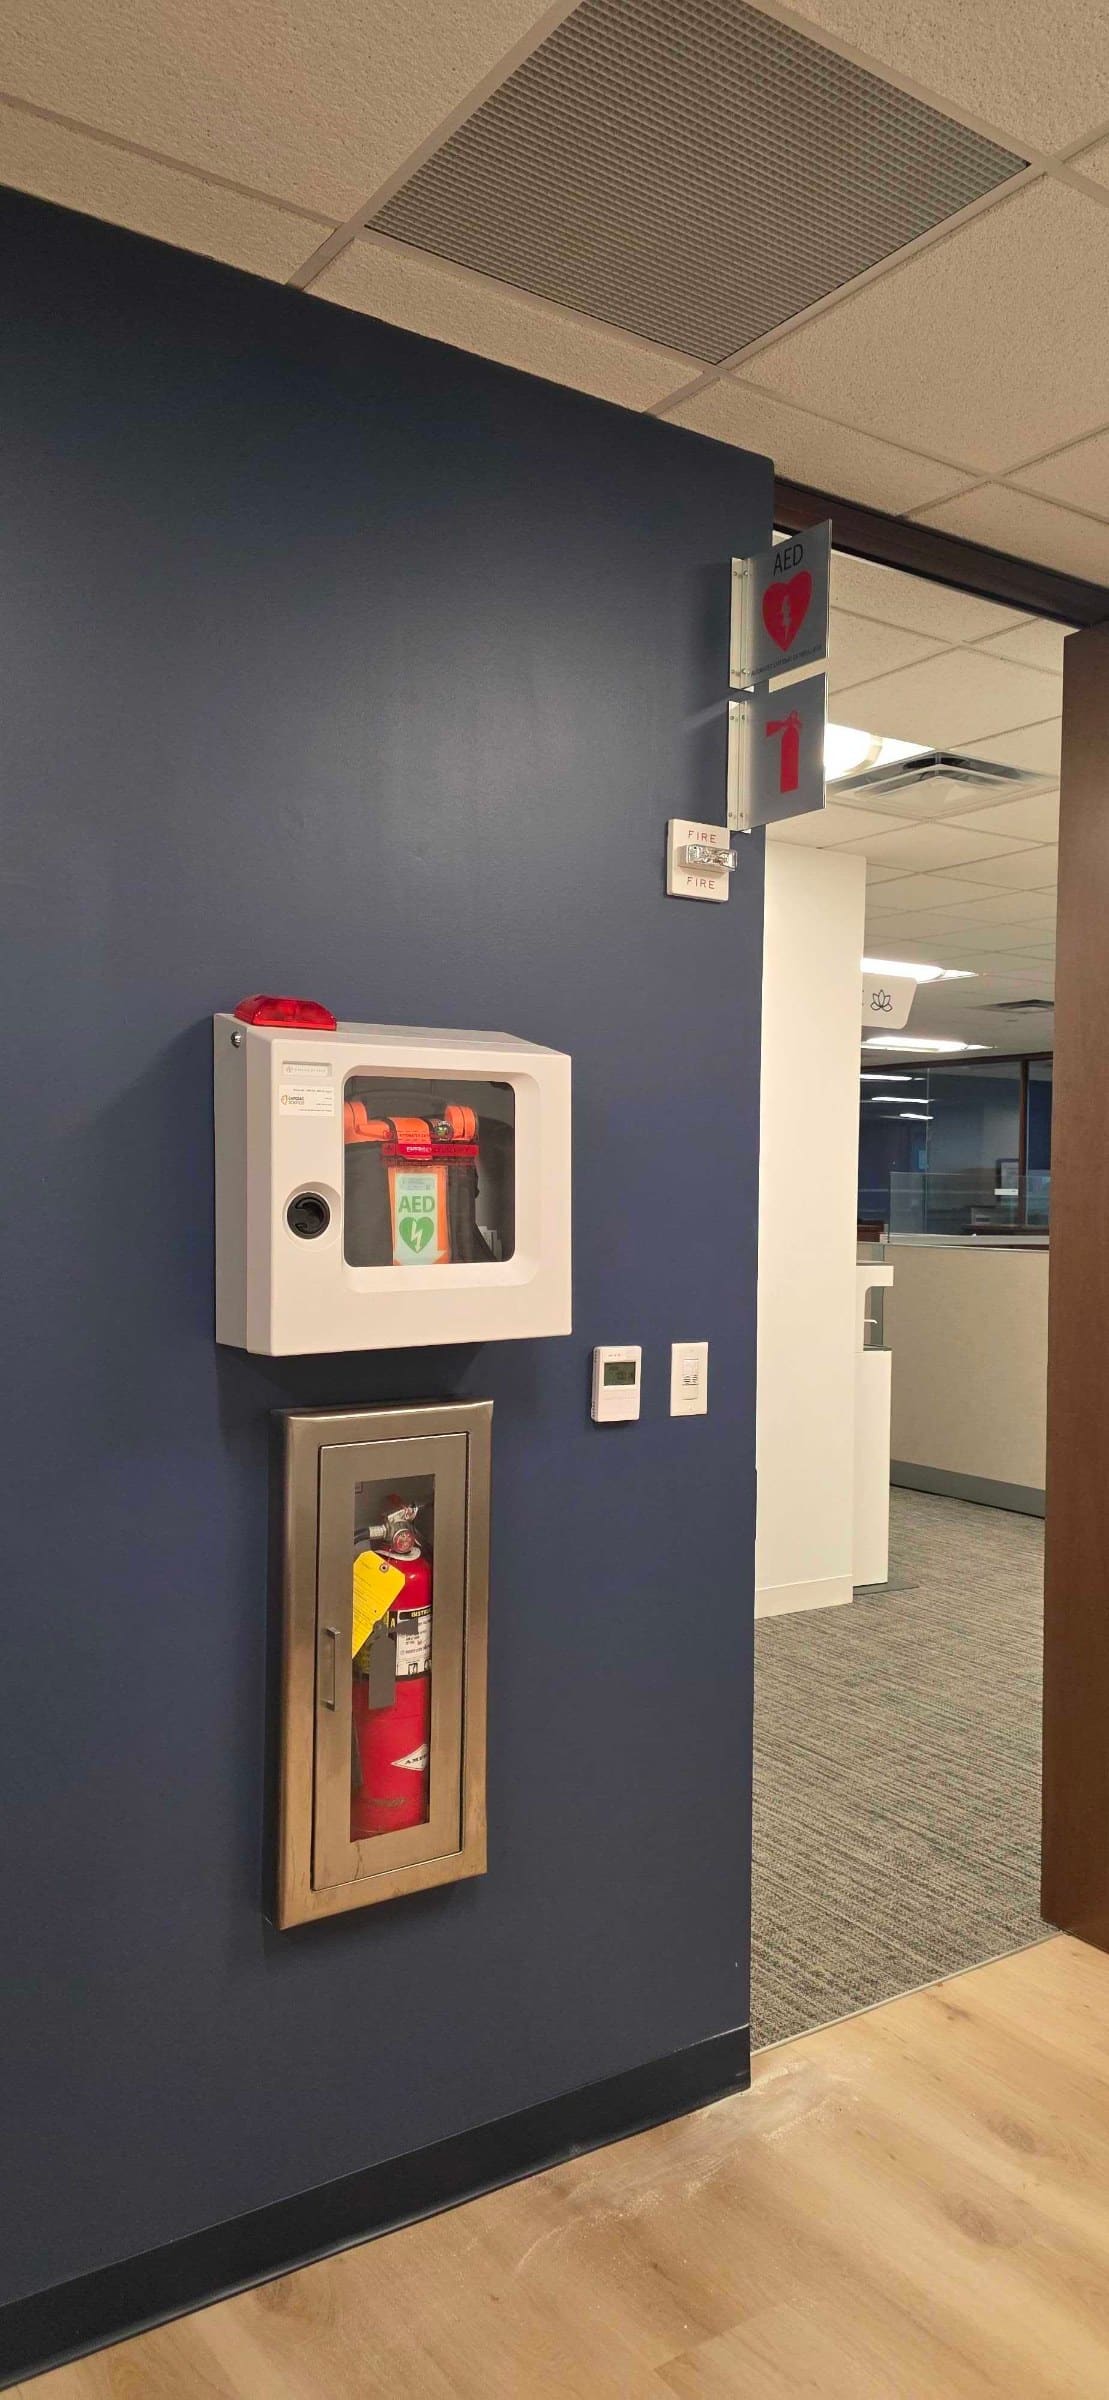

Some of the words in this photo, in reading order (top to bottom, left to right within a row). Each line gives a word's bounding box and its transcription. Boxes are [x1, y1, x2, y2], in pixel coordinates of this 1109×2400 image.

[773, 543, 804, 577] AED
[687, 829, 718, 844] FIRE
[686, 876, 716, 890] FIRE
[398, 1195, 436, 1213] AED
